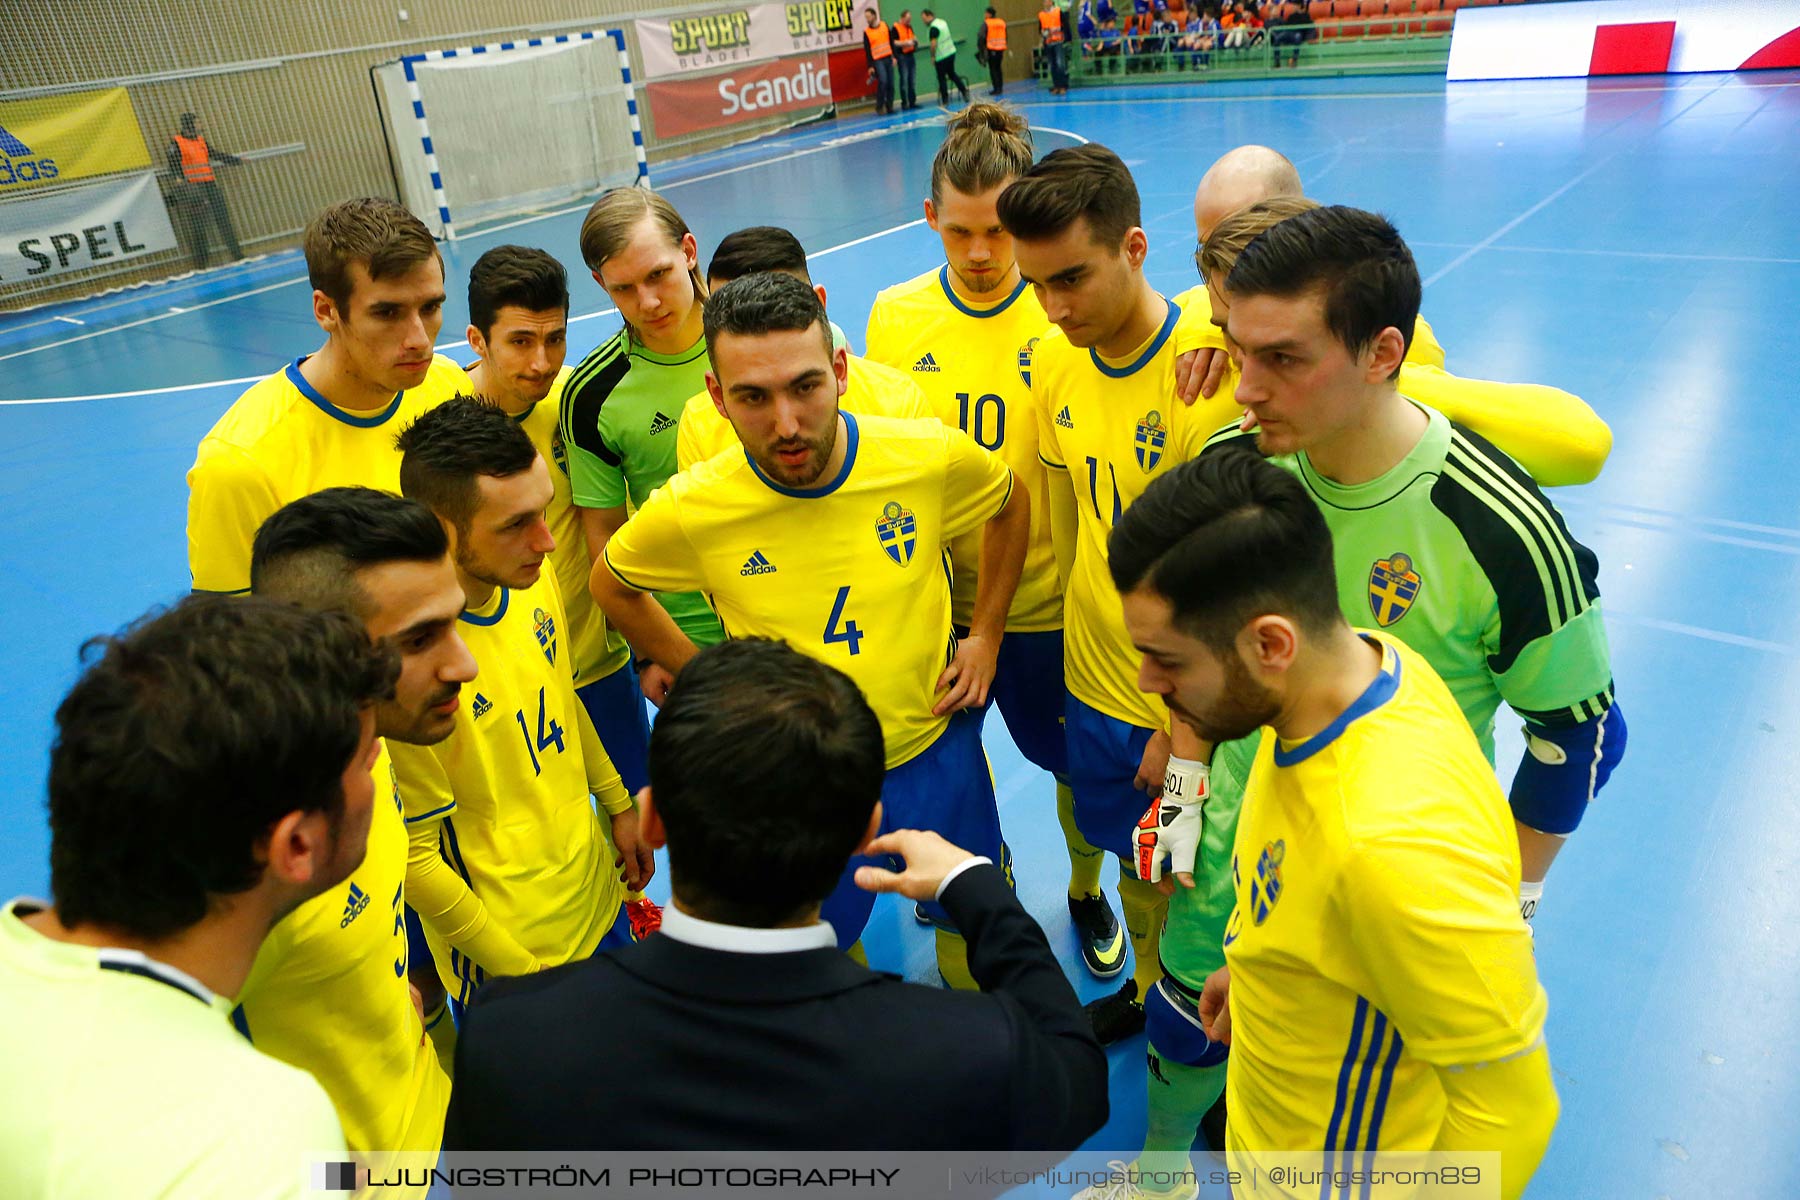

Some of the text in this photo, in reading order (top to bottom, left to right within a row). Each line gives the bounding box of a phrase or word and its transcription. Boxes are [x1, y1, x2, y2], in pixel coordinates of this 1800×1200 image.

[669, 10, 751, 55] SPORT
[785, 0, 854, 37] SPORT
[679, 48, 751, 69] BLADET
[793, 32, 854, 50] BLADET
[718, 62, 832, 116] Scandic
[18, 220, 146, 275] SPEL
[912, 364, 941, 373] adidas
[649, 419, 677, 436] adidas
[955, 392, 1006, 452] 10
[740, 564, 777, 577] adidas
[823, 586, 864, 656] 4
[516, 686, 565, 777] 14
[340, 893, 370, 929] adidas
